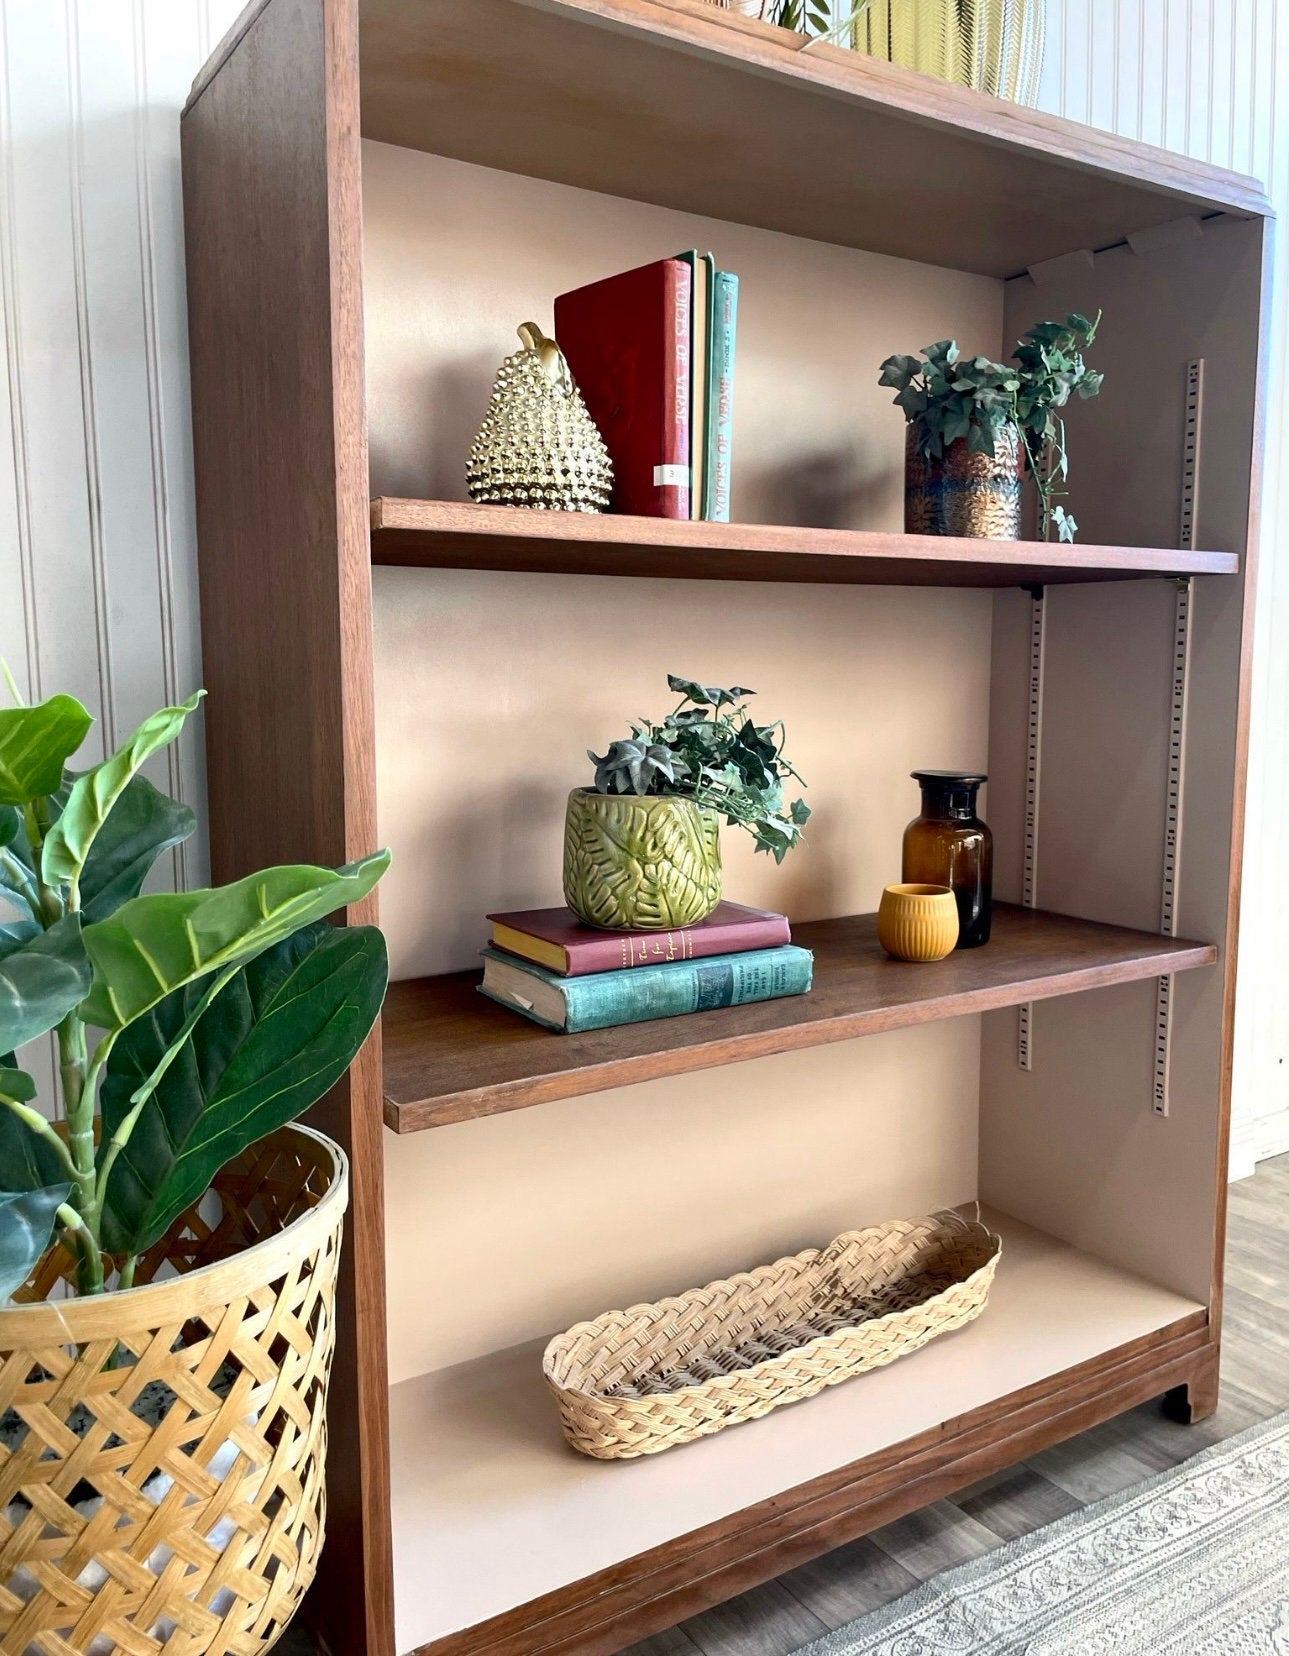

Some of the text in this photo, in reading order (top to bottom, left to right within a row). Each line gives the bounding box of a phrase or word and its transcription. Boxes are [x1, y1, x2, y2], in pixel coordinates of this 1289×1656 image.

[675, 280, 688, 337] VOICES
[675, 344, 688, 366] OF
[675, 375, 688, 425] VERSE
[717, 433, 728, 454] OF
[715, 462, 728, 516] VOICES
